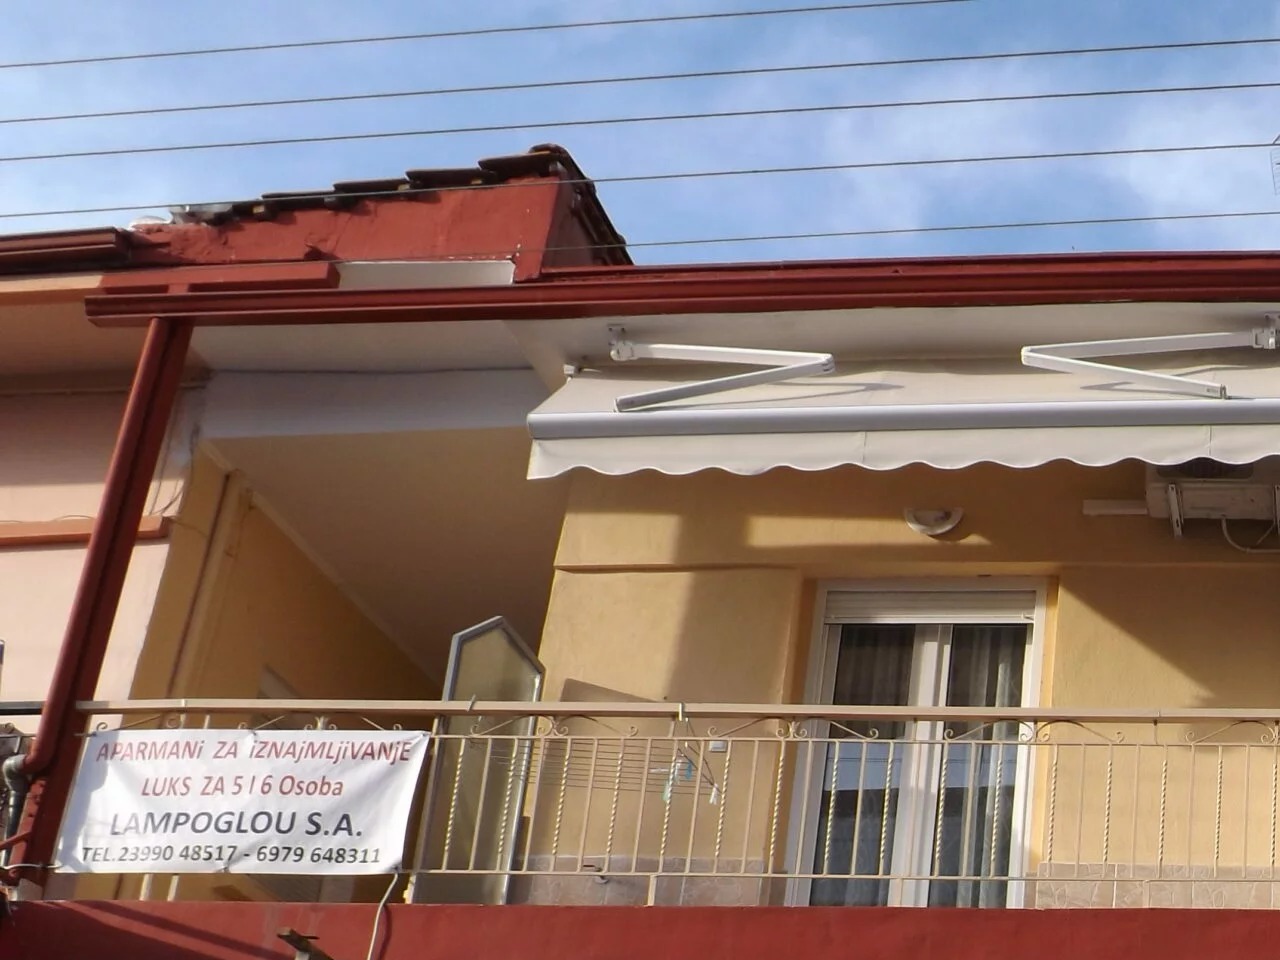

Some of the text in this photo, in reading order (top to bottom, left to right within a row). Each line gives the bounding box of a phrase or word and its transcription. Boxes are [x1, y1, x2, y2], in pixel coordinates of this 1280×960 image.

[212, 741, 238, 760] ZA
[141, 776, 192, 797] LUKS
[200, 775, 225, 796] ZA
[231, 775, 243, 796] 5
[260, 774, 273, 796] 6
[278, 774, 344, 797] Osoba
[110, 811, 363, 837] LAMPOGLOU S.A.
[82, 845, 174, 863] TEL.23990
[179, 845, 238, 862] 48517
[256, 846, 305, 863] 6979
[310, 847, 381, 864] 648311
